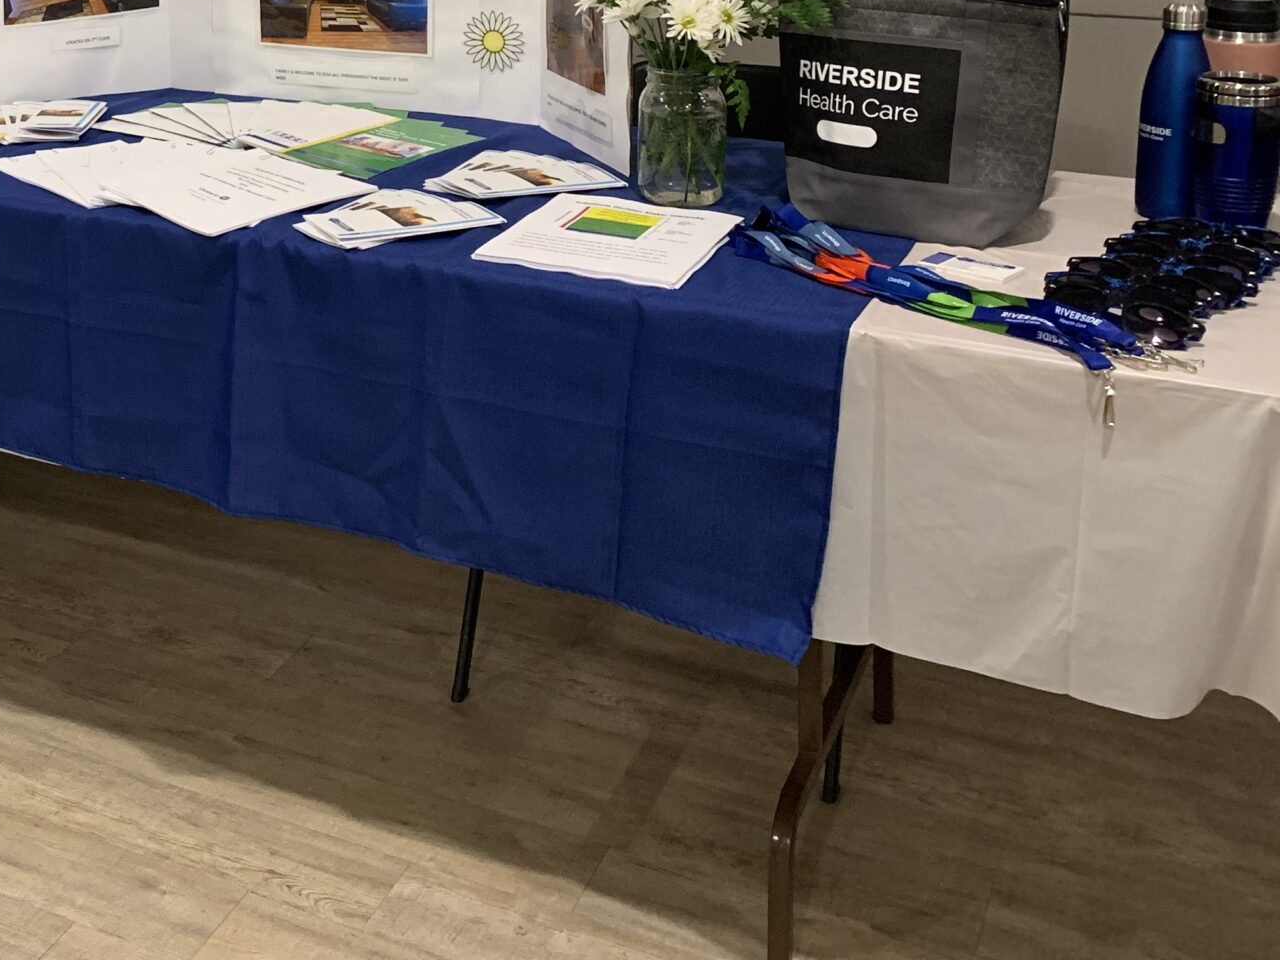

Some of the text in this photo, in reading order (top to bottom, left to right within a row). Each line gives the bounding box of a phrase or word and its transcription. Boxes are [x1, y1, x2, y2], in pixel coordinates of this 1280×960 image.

[799, 59, 921, 94] RIVERSIDE
[799, 87, 918, 123] Health Care
[1055, 306, 1103, 327] RIVERSIDE
